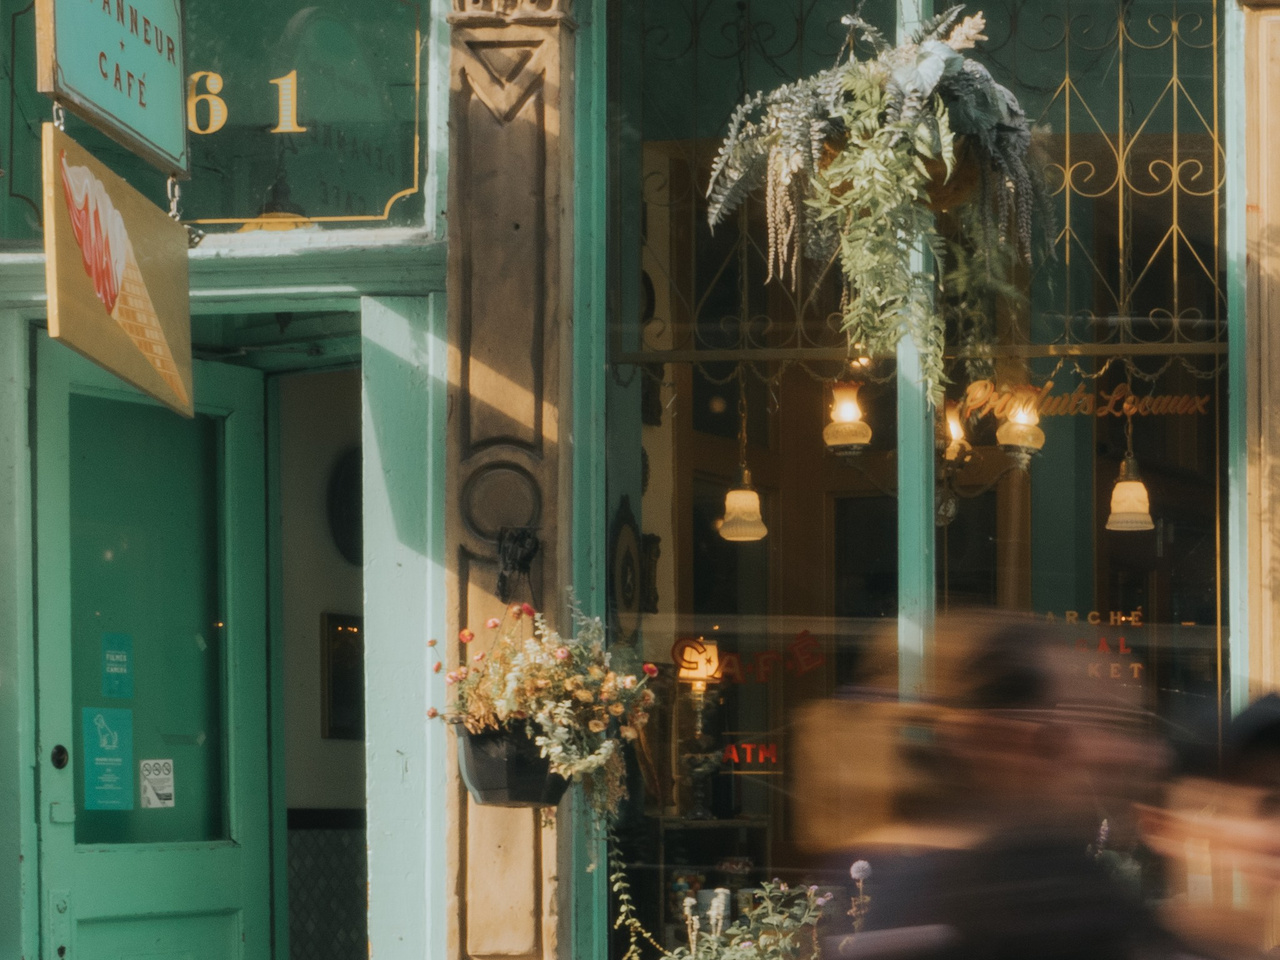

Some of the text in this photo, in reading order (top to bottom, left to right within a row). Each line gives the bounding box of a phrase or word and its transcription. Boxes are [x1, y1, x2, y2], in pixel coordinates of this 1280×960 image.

[90, 0, 176, 66] ANNEUR
[98, 51, 147, 109] CAFÉ
[1045, 605, 1144, 628] ARCHÉ
[722, 743, 778, 764] ATM
